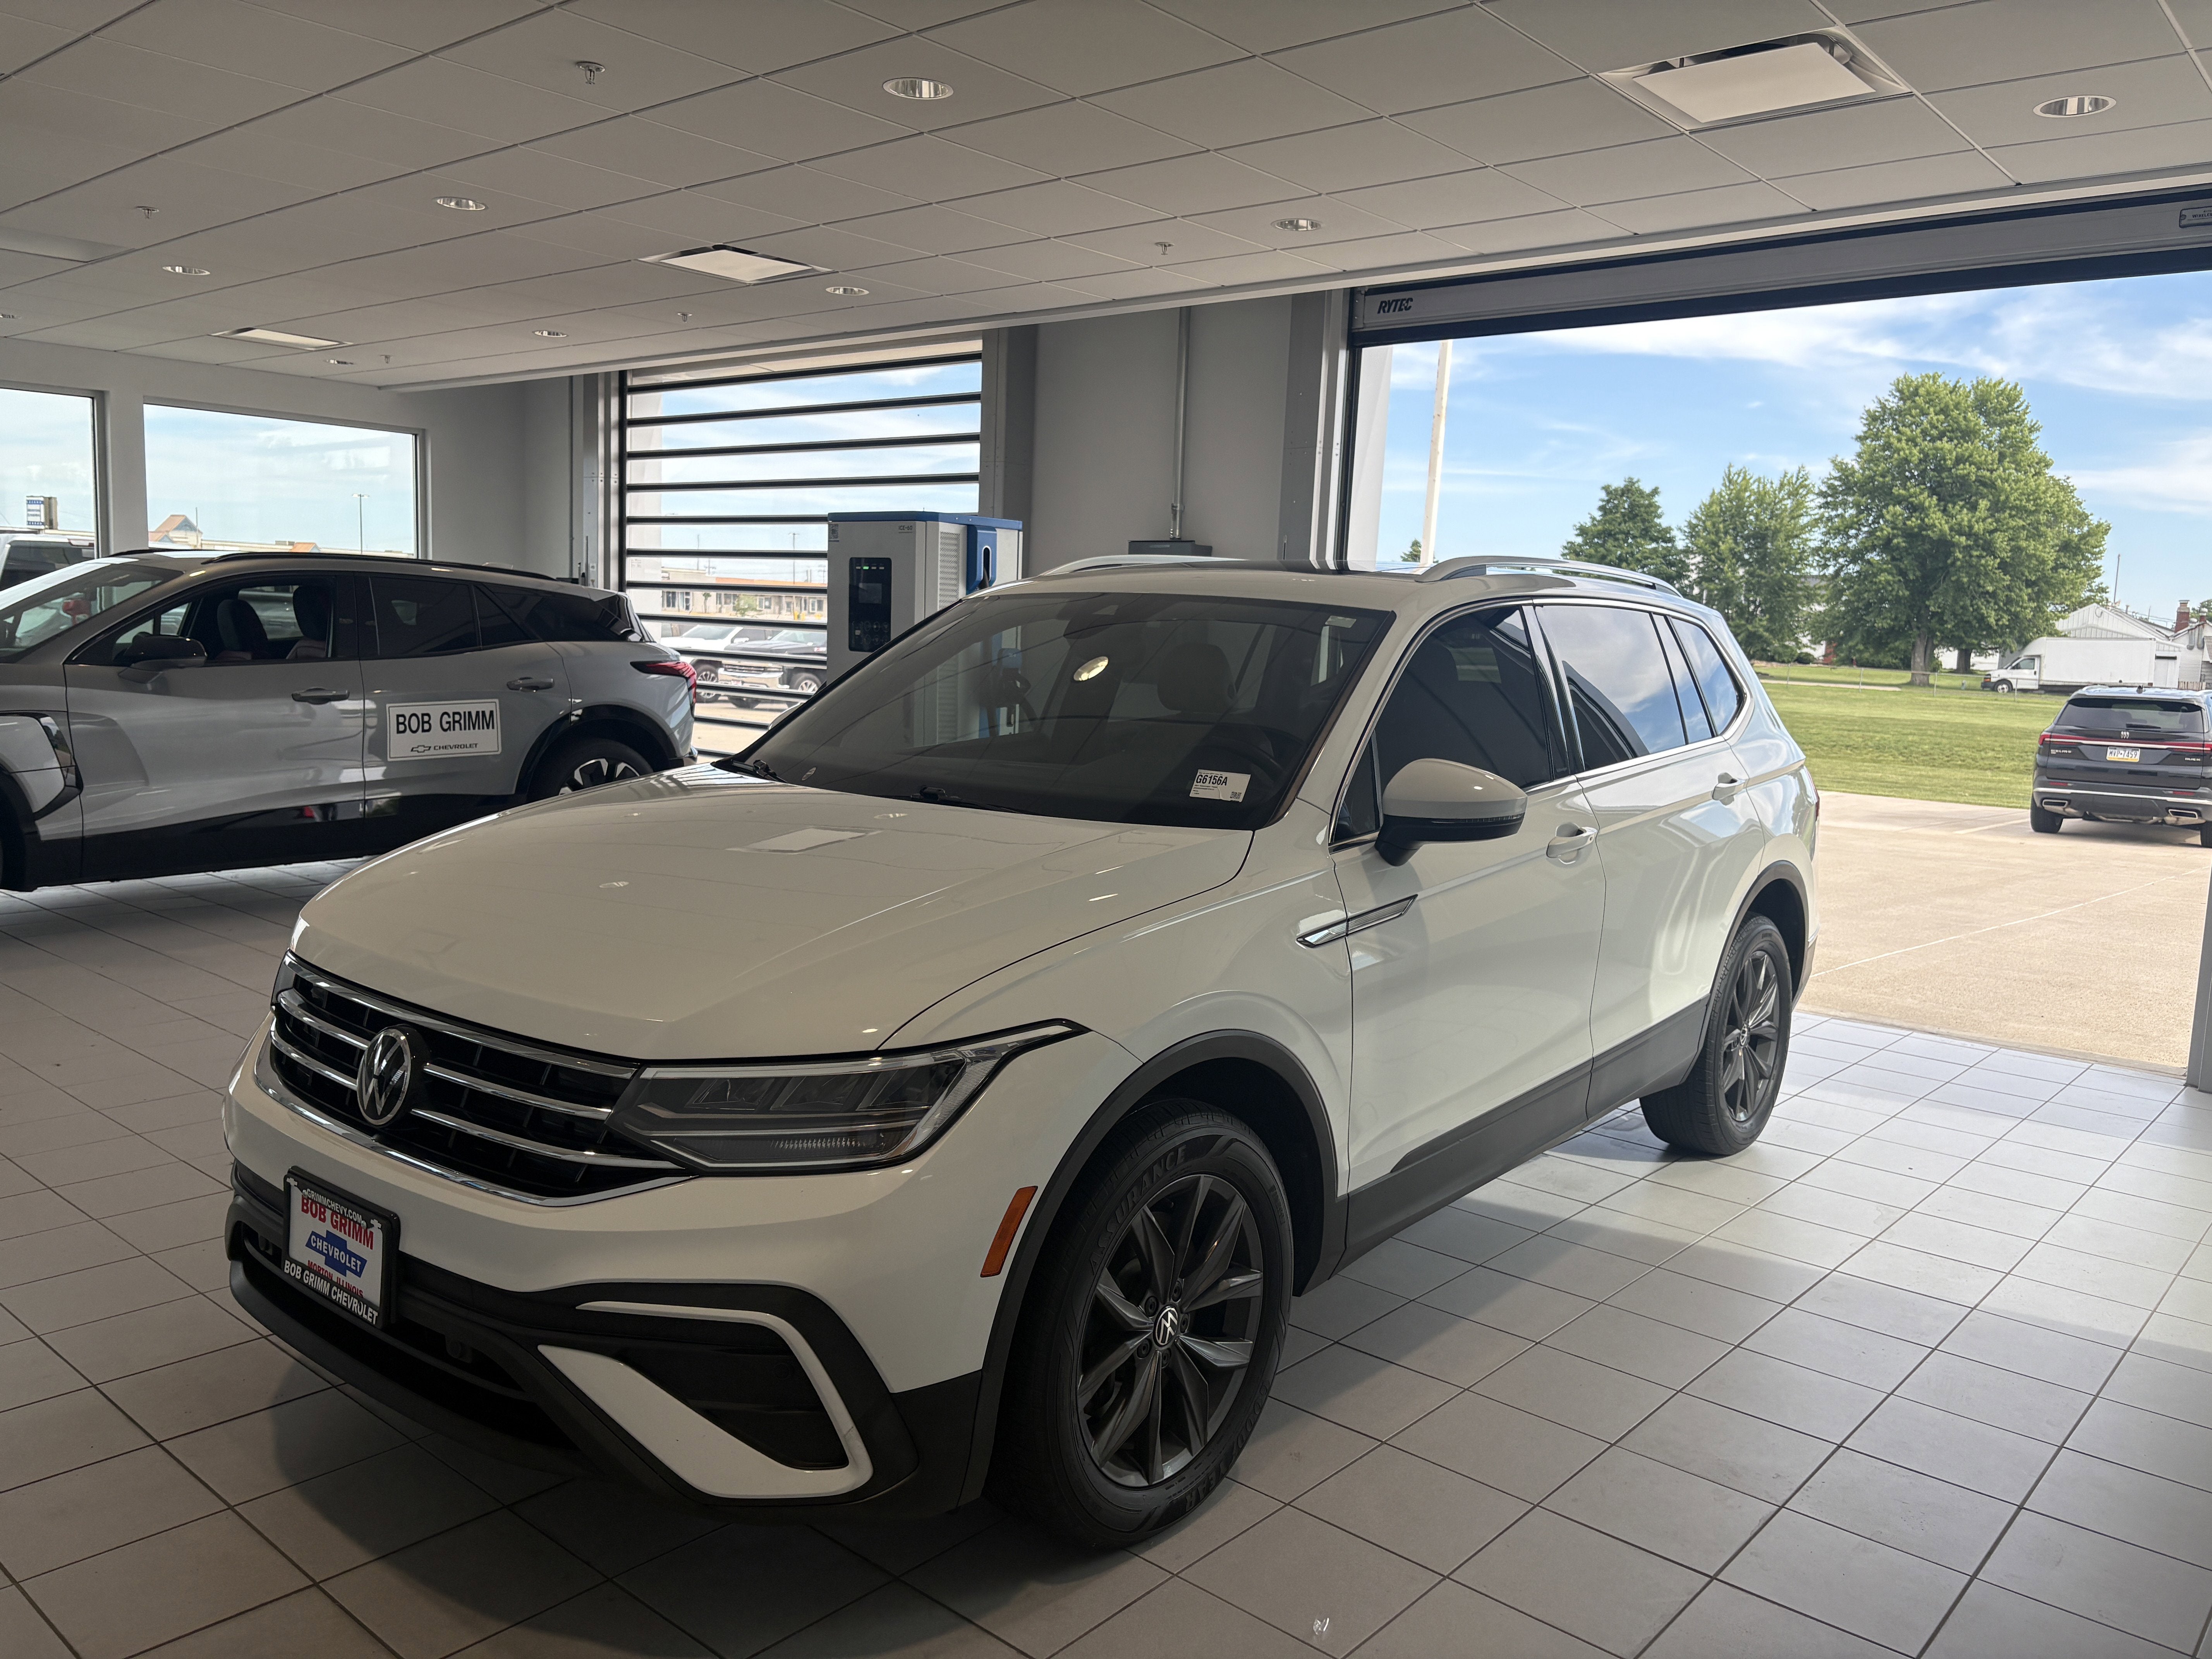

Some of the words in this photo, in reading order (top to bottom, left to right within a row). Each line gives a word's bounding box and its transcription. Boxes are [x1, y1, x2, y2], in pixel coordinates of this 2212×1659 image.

[1377, 297, 1413, 314] RYTEC
[396, 713, 432, 734] BOB
[440, 710, 495, 732] GRIMM
[1196, 774, 1228, 786] G6156A
[301, 1195, 326, 1223] BOB
[330, 1211, 374, 1250] GRIMM
[307, 1188, 362, 1224] GRIMMCHEVY.COM
[1089, 1144, 1187, 1275] ASSURANCE
[311, 1235, 362, 1273] CHEVROLET
[284, 1260, 302, 1280] BOB
[303, 1271, 331, 1296] GRIMM
[331, 1286, 378, 1325] CHEVROLET
[307, 1260, 333, 1281] MORTON
[337, 1276, 364, 1298] ILLINOIS
